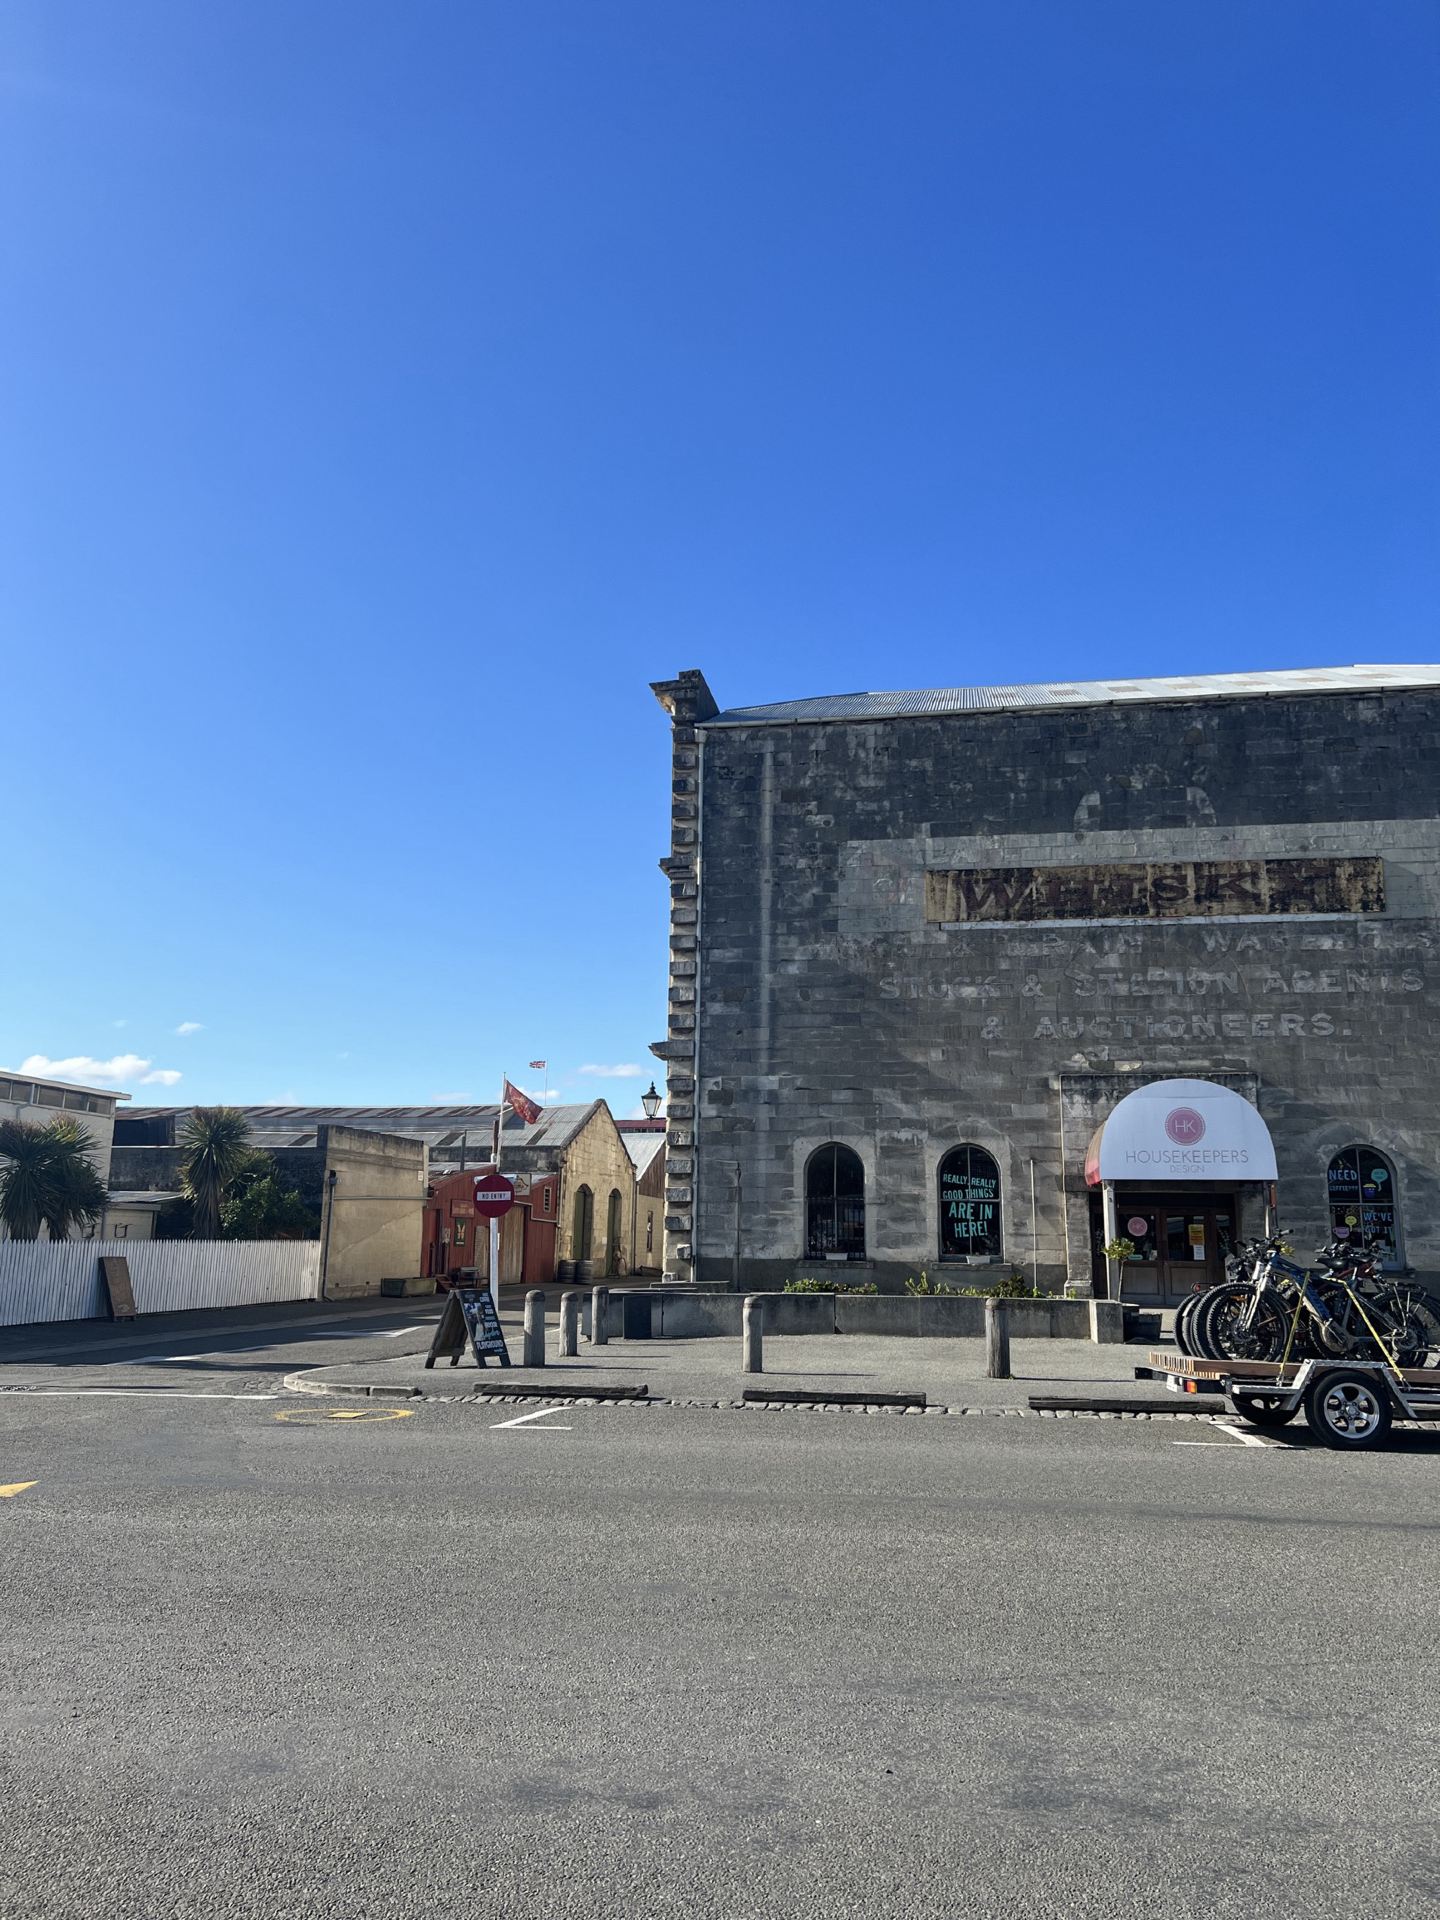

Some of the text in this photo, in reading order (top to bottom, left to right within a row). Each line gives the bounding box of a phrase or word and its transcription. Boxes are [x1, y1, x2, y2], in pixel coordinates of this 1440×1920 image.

[1022, 974, 1045, 998] &
[1263, 967, 1425, 993] AGENTS
[980, 1016, 1001, 1040] &
[1174, 1119, 1196, 1133] HK
[1125, 1150, 1249, 1164] HOUSEKEEPERS
[1169, 1165, 1205, 1174] DESIGN
[1328, 1169, 1358, 1181] NEED
[970, 1177, 996, 1188] REALLY
[942, 1187, 994, 1200] GOOD THINGS
[948, 1201, 993, 1220] ARE IN
[1363, 1212, 1393, 1222] WE'VE
[954, 1220, 989, 1238] HERE!
